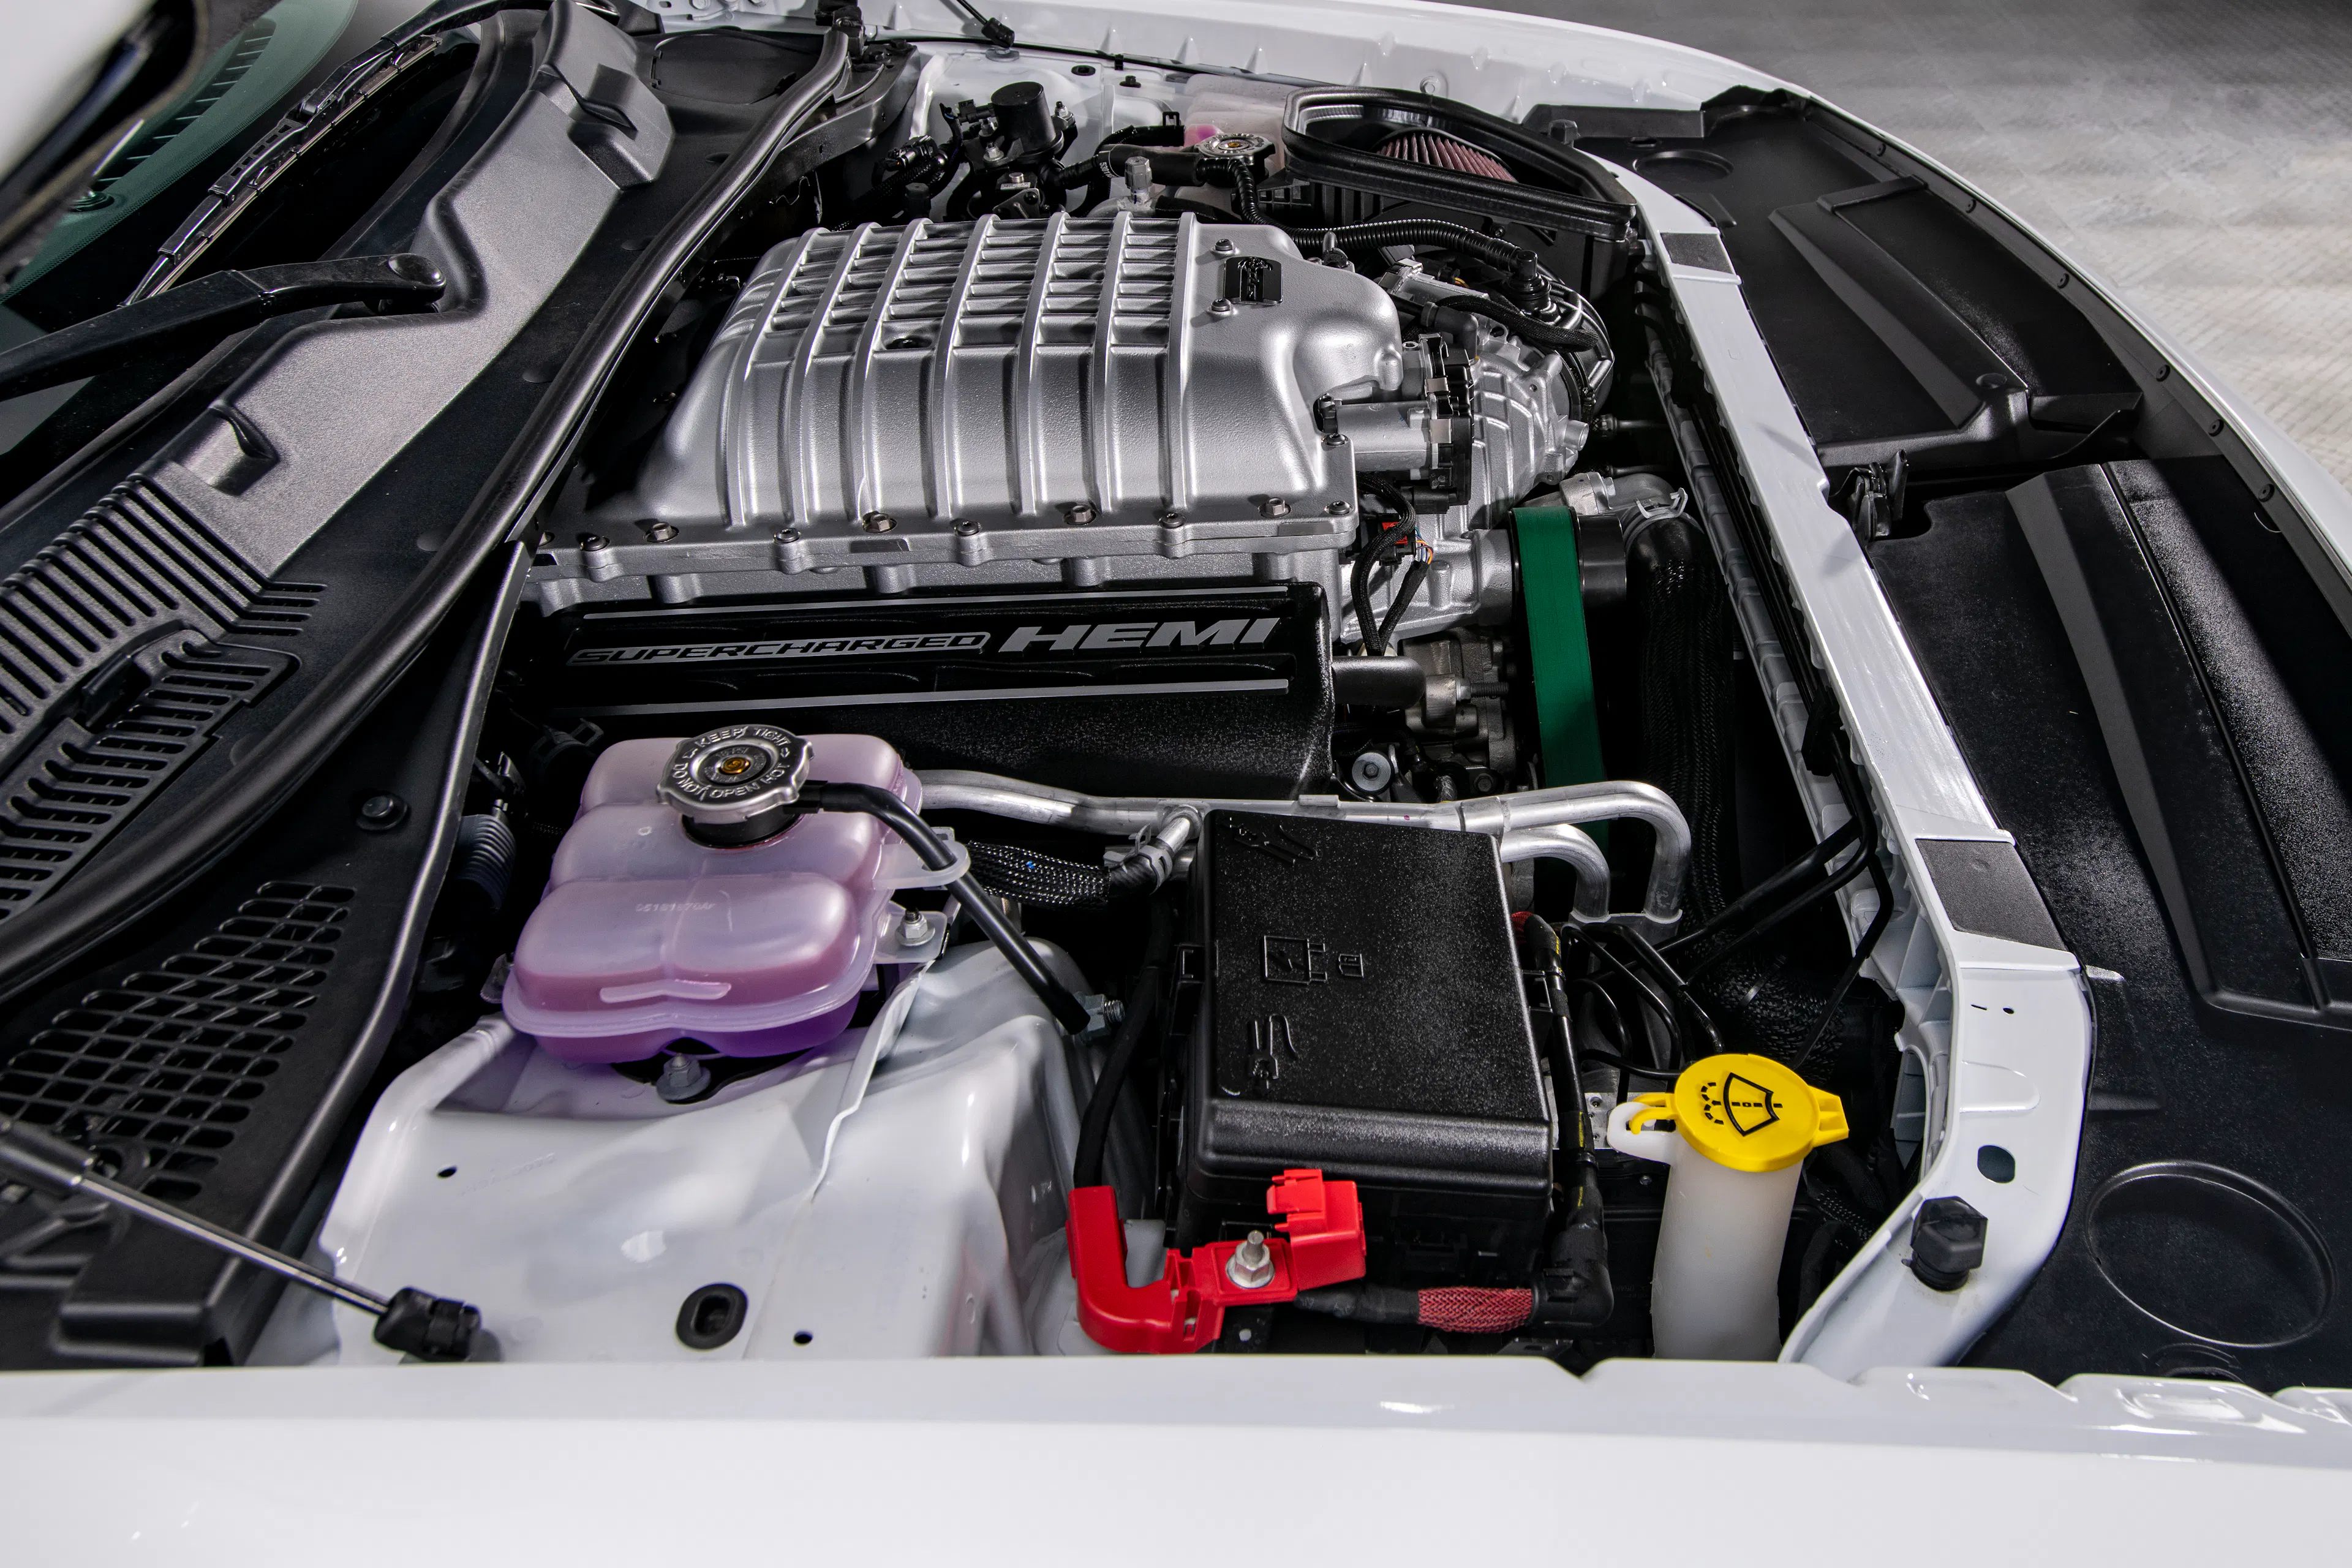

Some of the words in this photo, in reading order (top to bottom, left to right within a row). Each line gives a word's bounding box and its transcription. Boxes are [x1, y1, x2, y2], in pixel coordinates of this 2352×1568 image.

[571, 634, 986, 663] SUPERCHARGED
[998, 617, 1280, 652] HEMI
[695, 728, 744, 748] KEEP
[753, 727, 791, 746] TIGHT
[673, 762, 688, 779] DO
[760, 762, 790, 785] HOT
[677, 777, 712, 796] NOT
[709, 782, 761, 799] OPEN
